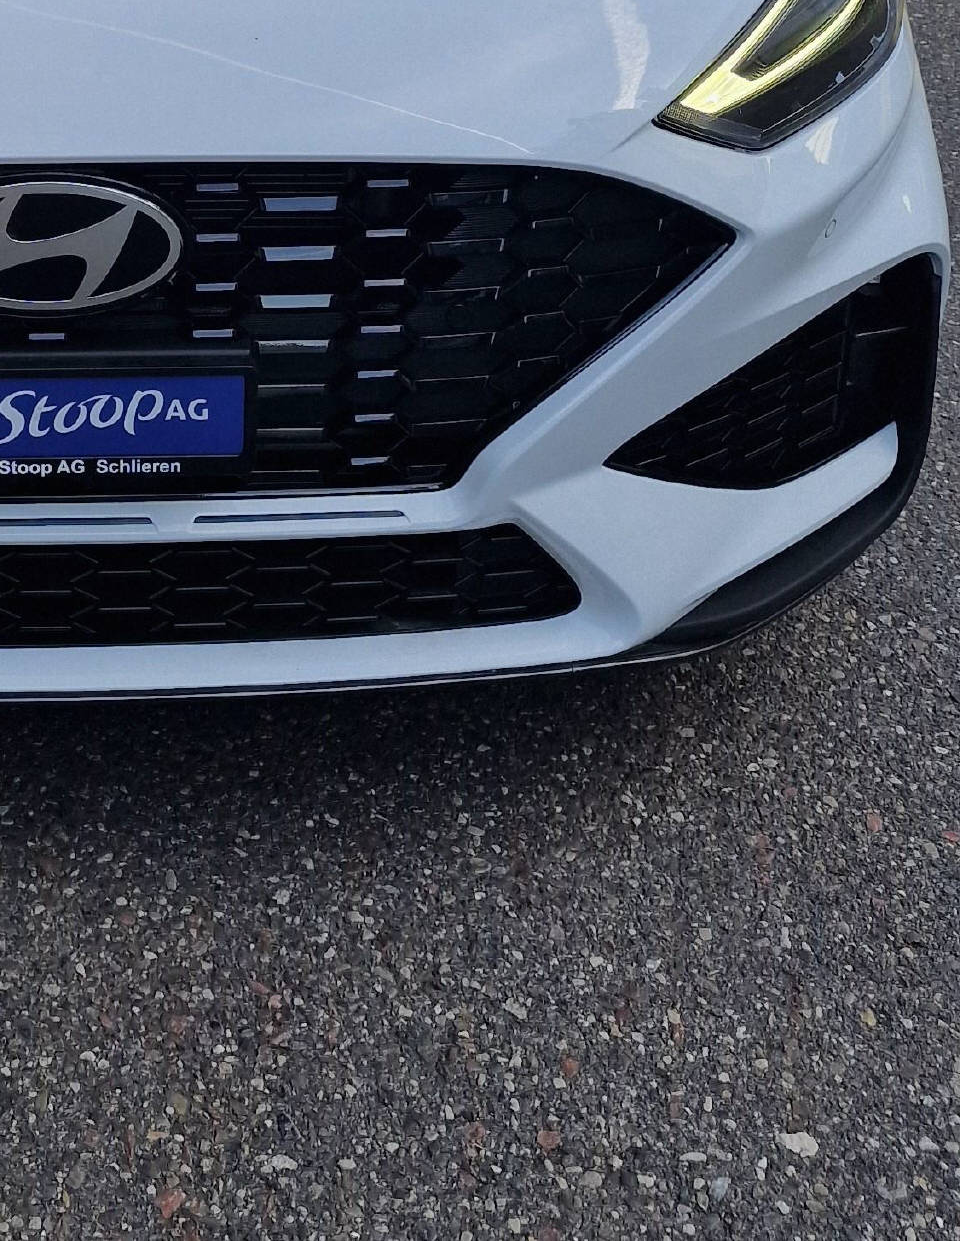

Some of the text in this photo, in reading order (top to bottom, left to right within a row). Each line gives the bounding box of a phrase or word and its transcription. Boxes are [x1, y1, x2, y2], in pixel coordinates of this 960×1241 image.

[164, 398, 209, 422] AG
[57, 460, 85, 474] AG
[96, 459, 181, 474] Schlieren
